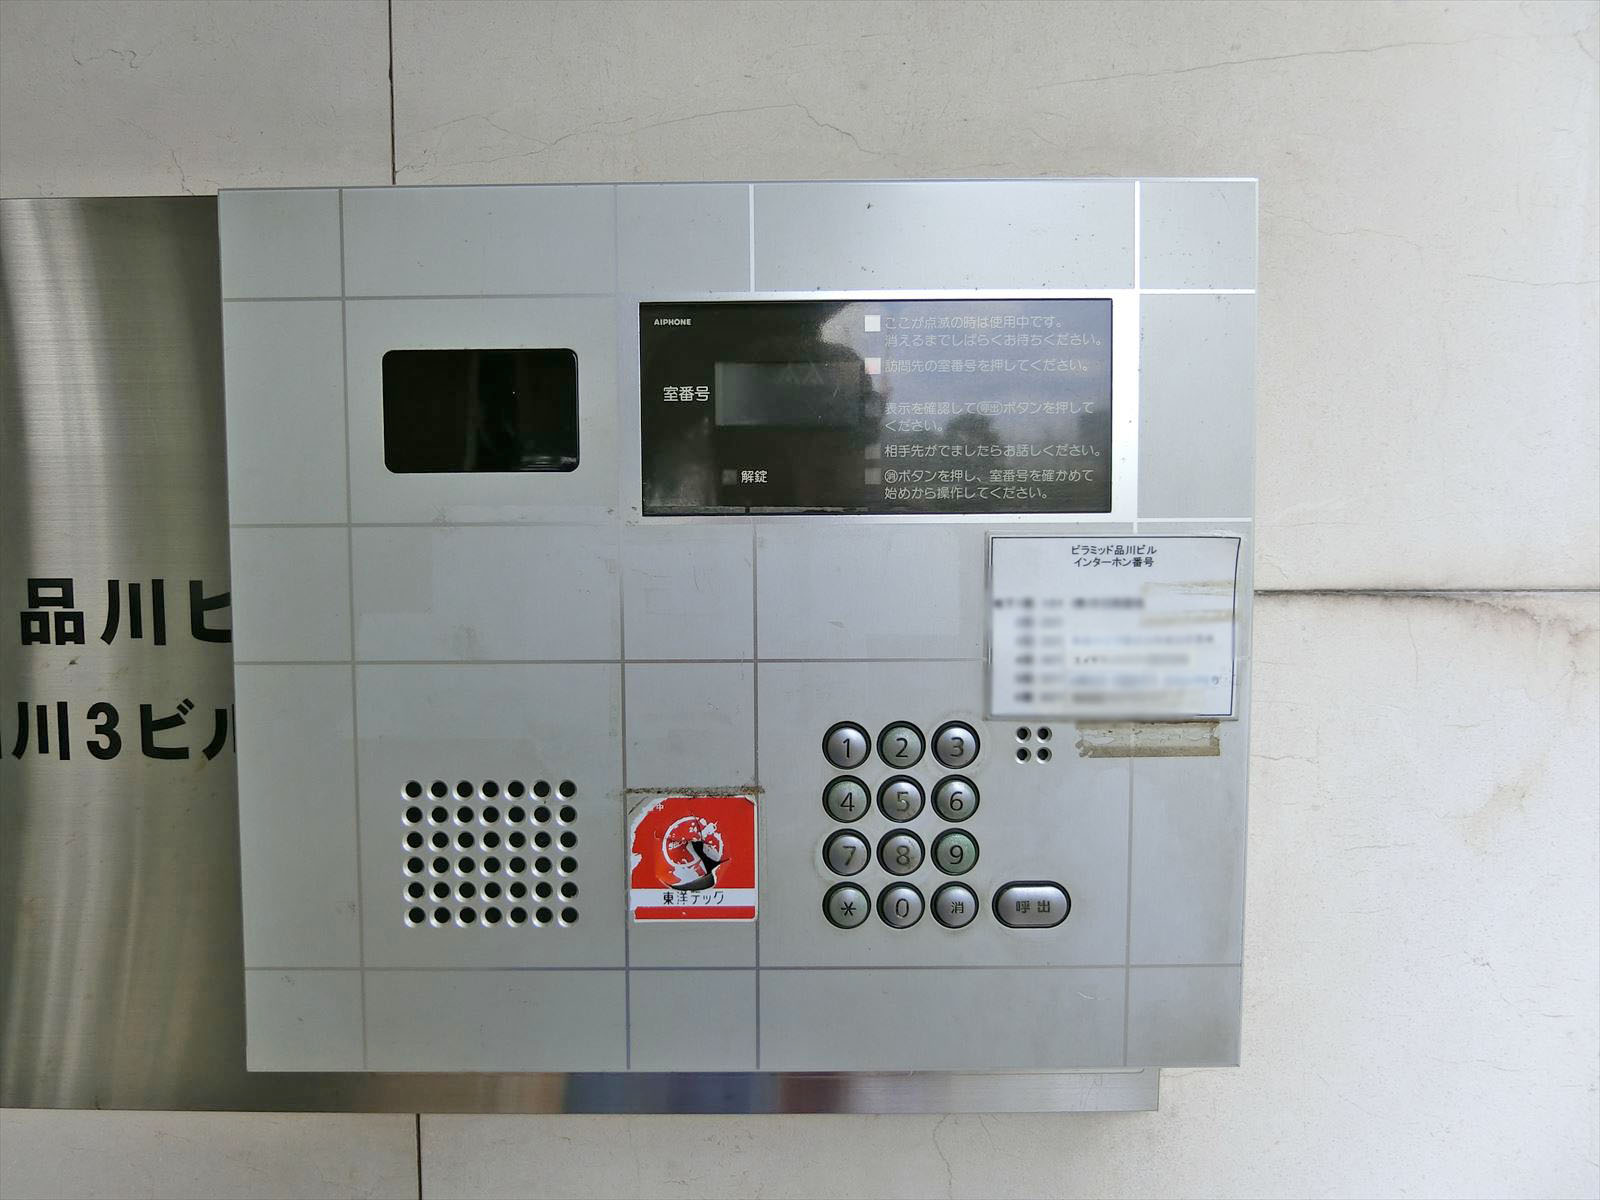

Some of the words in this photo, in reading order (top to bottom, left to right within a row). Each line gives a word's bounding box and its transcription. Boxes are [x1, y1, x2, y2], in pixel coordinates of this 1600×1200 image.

[653, 318, 692, 326] AIPHONE
[884, 315, 1062, 330] ここが点滅の時は使用中です。
[884, 333, 1102, 347] 消えるまでしばらくお待ちください。
[884, 358, 1089, 373] 訪問先の室番号を押してください。
[663, 385, 710, 402] 室番号
[884, 419, 944, 432] ください。
[884, 444, 1102, 458] 相手先がでましたらお話しください。
[740, 470, 768, 483] 解錠
[884, 487, 1048, 501] 始めから操作してください。
[1073, 556, 1154, 568] インターホン番号
[842, 737, 851, 758] 1
[895, 737, 908, 758] 2
[950, 737, 964, 757] 3
[840, 792, 855, 812] 4
[896, 791, 910, 812] 5
[949, 791, 963, 811] 6
[842, 846, 856, 866] 7
[896, 845, 910, 865] 8
[950, 845, 964, 864] 9
[663, 890, 724, 905] 東洋テック
[896, 898, 909, 918] 0
[951, 901, 964, 914] 消
